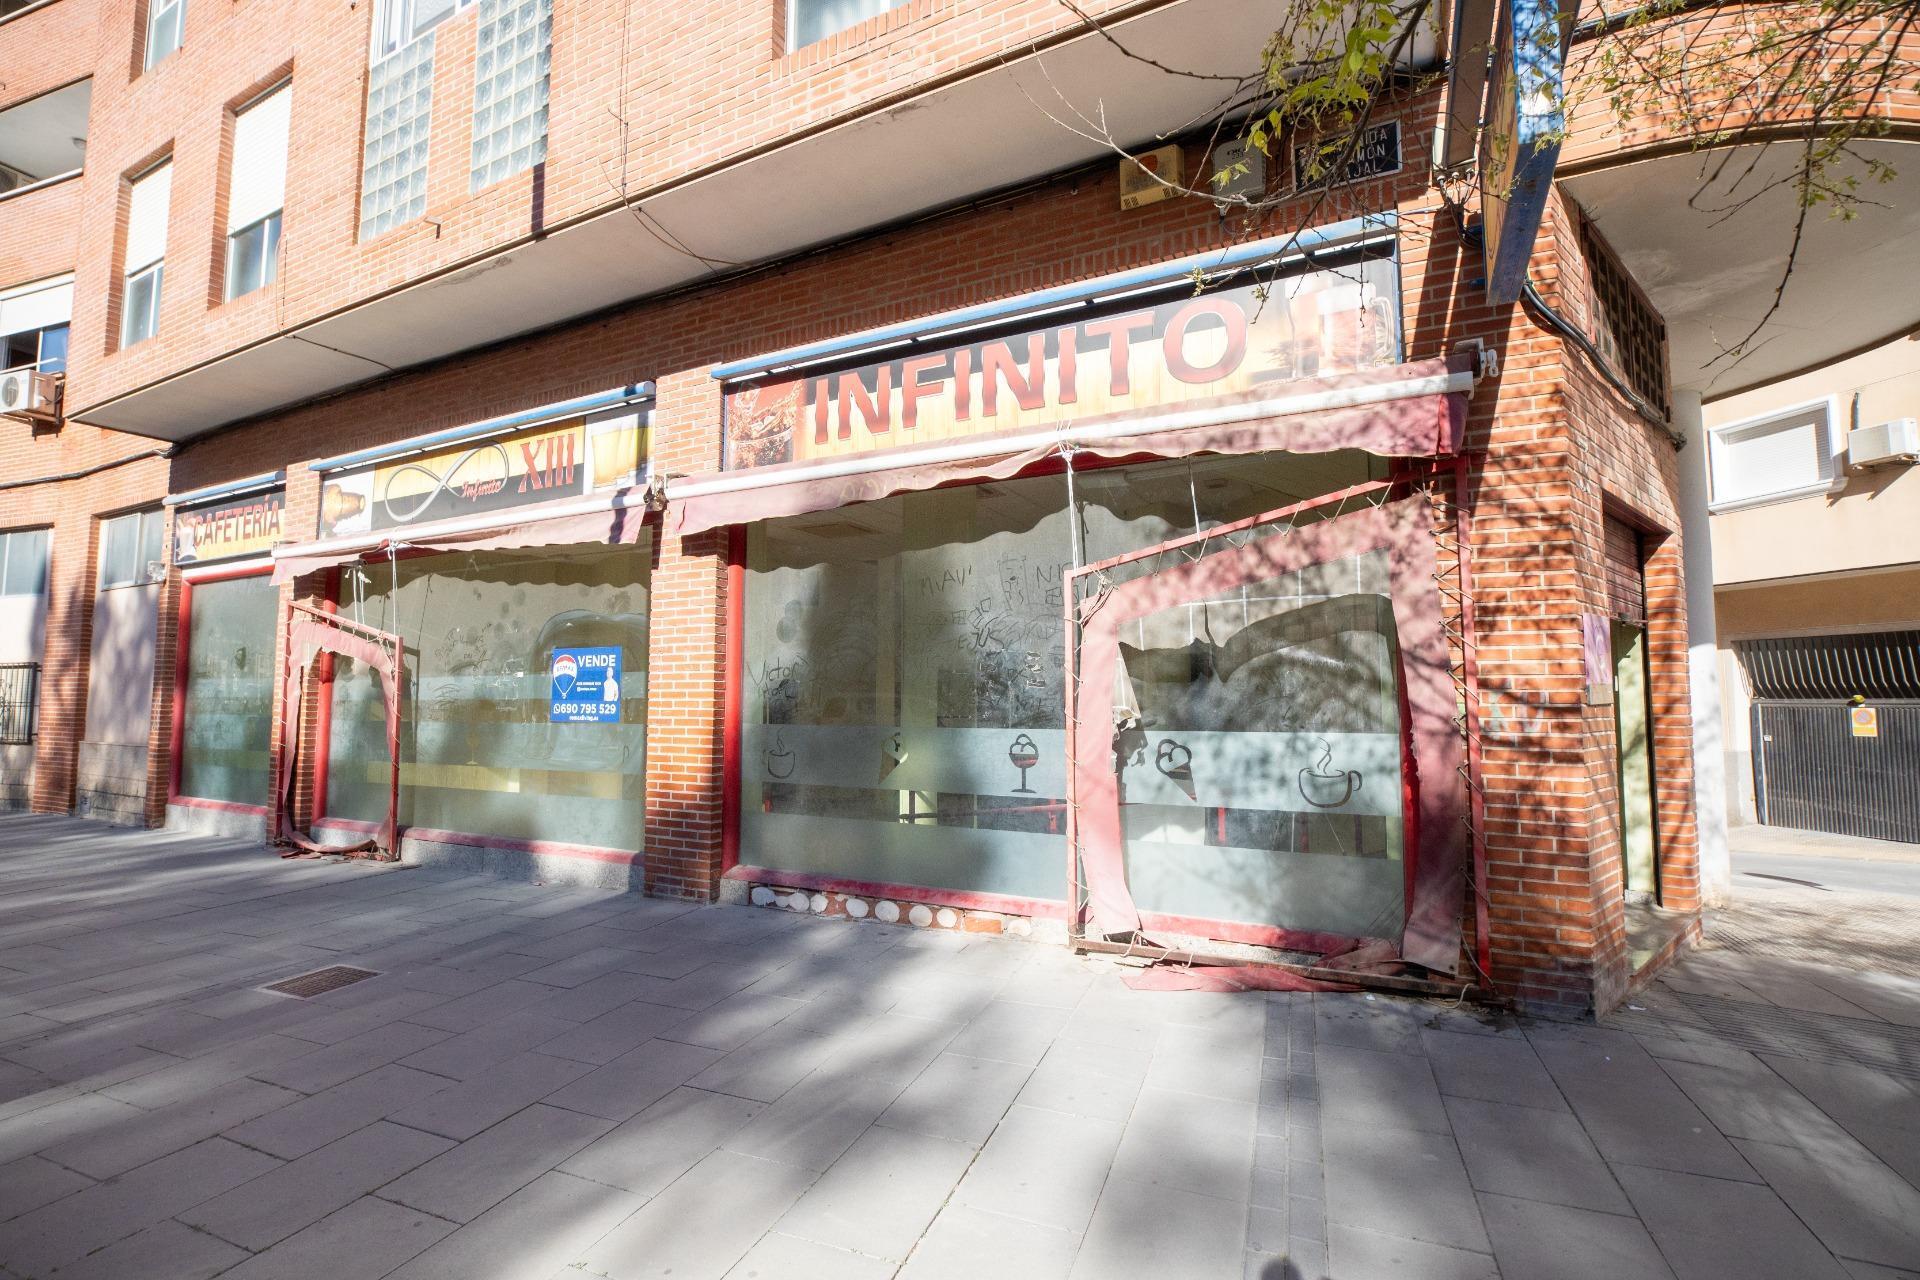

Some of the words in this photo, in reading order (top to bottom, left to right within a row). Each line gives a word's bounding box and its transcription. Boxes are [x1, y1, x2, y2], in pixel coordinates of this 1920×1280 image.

[814, 298, 1248, 445] INFINITO
[518, 433, 575, 493] XIII
[193, 494, 281, 548] CAFETERÍA
[578, 655, 616, 667] VENDE
[561, 703, 577, 714] 690
[580, 703, 596, 714] 795
[599, 703, 616, 714] 529
